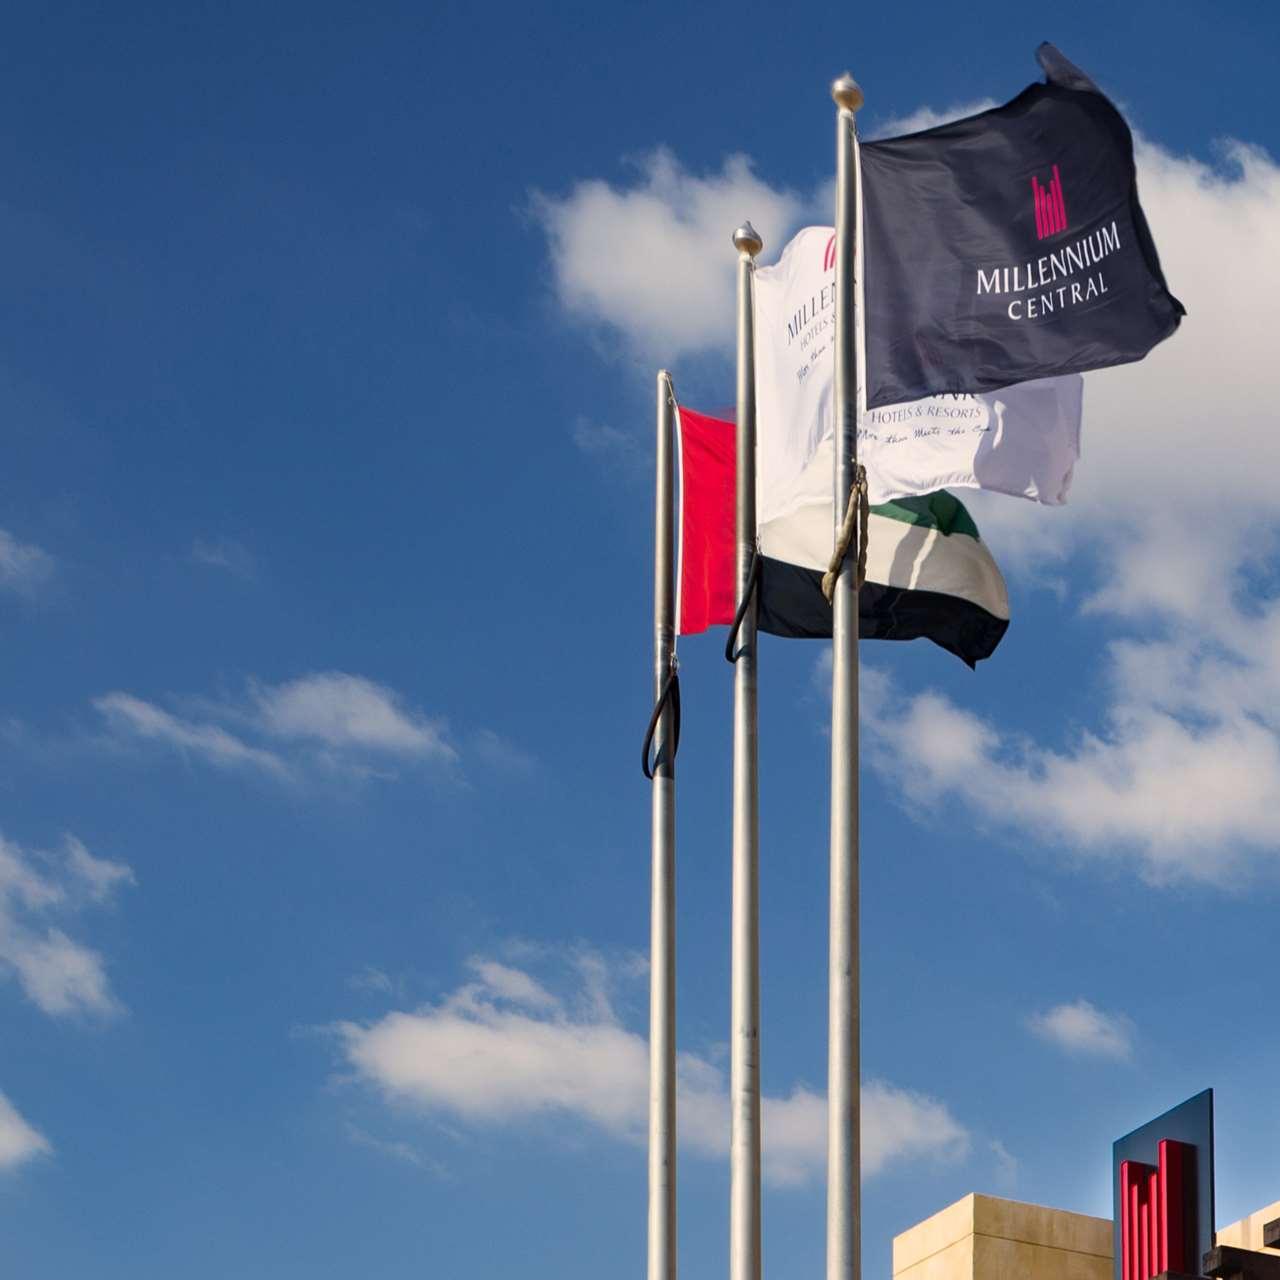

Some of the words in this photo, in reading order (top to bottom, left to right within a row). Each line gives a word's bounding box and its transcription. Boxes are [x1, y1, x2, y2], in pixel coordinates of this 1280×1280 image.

[977, 221, 1121, 295] MILLENNIUM
[1007, 272, 1108, 320] CENTRAL
[871, 405, 913, 425] HOTELS
[915, 405, 923, 417] &
[926, 403, 982, 420] RESORTS
